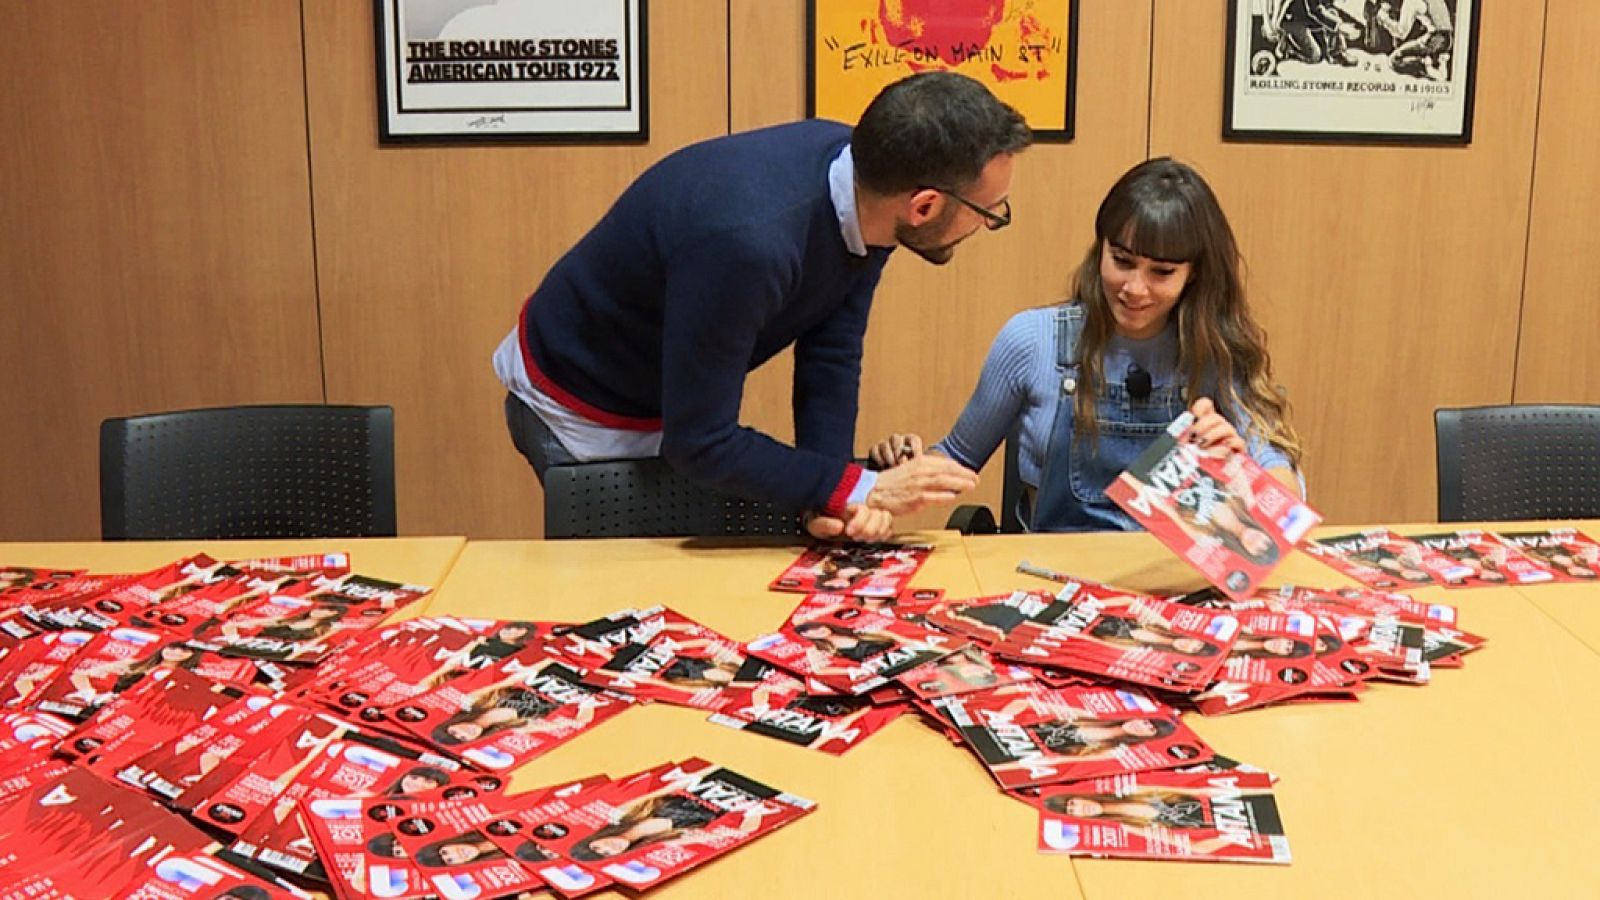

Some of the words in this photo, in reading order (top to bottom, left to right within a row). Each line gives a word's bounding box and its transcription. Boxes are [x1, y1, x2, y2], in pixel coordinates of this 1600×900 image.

[407, 42, 445, 58] THE
[450, 40, 536, 57] ROLLING
[538, 38, 618, 56] STONES
[913, 45, 938, 62] ON
[951, 41, 1003, 63] MAIN
[409, 63, 513, 81] AMERICAN
[515, 62, 572, 80] TOUR
[574, 62, 618, 80] 1972
[1250, 79, 1300, 90] ROLLING
[1301, 81, 1344, 91] STONES
[1346, 81, 1397, 92] RECORDS
[974, 708, 1058, 779] AITANA
[1208, 777, 1255, 849] AITANA
